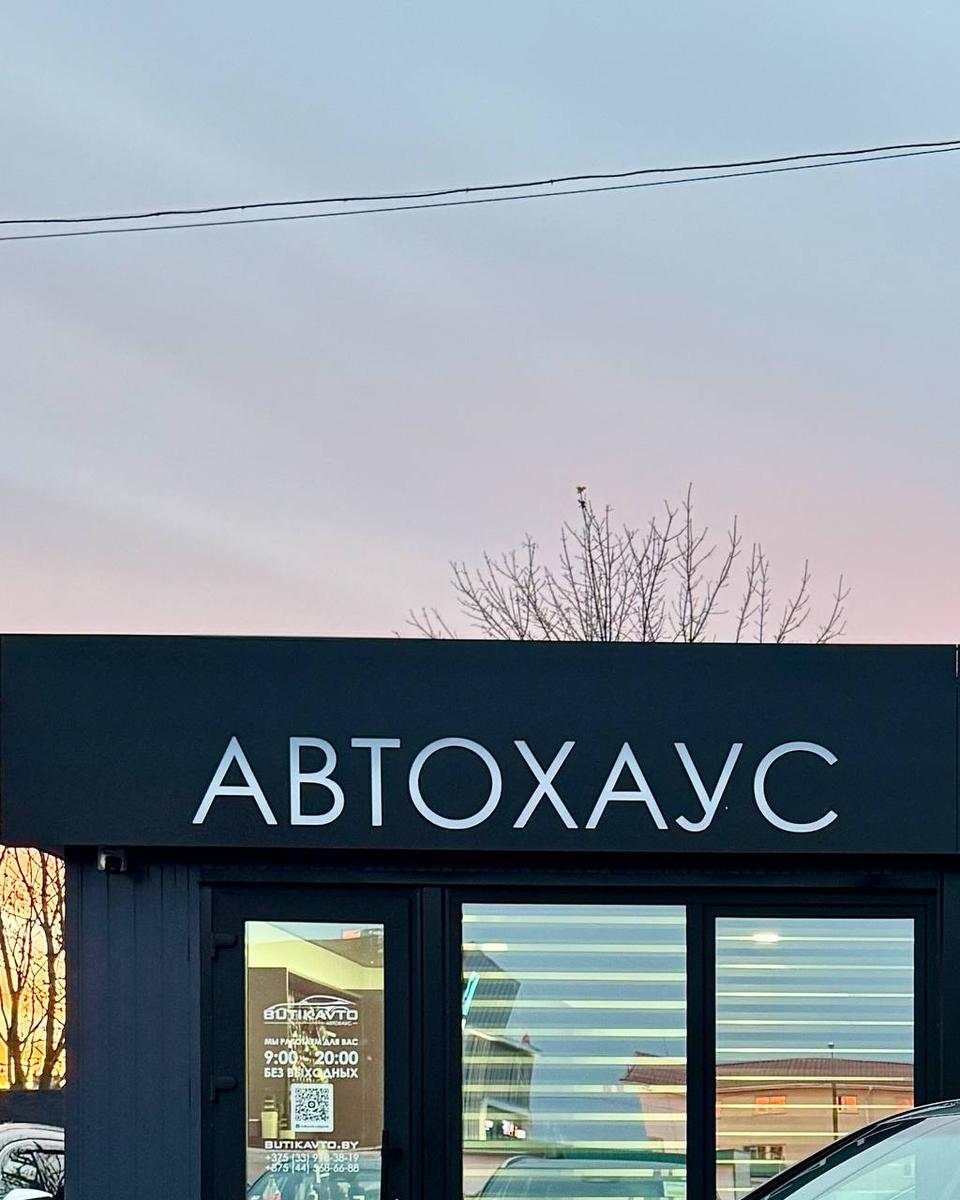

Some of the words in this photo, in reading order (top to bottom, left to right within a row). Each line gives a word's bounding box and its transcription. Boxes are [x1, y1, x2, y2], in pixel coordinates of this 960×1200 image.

[192, 736, 839, 833] АВТОХАУС
[263, 1009, 359, 1020] BUTIKAVTO
[323, 1038, 340, 1046] ДЛЯ
[341, 1038, 359, 1046] ВАС
[264, 1051, 298, 1065] 9:00
[315, 1051, 359, 1065] 20:00
[264, 1068, 284, 1077] БЕЗ
[287, 1068, 359, 1079] ВЫХОДНЫХ
[264, 1141, 359, 1149] BUTIKAVTO.BY
[265, 1153, 289, 1162] +375
[292, 1153, 310, 1164] (33)
[312, 1153, 359, 1162] 9-38-19
[292, 1163, 310, 1174] (44)
